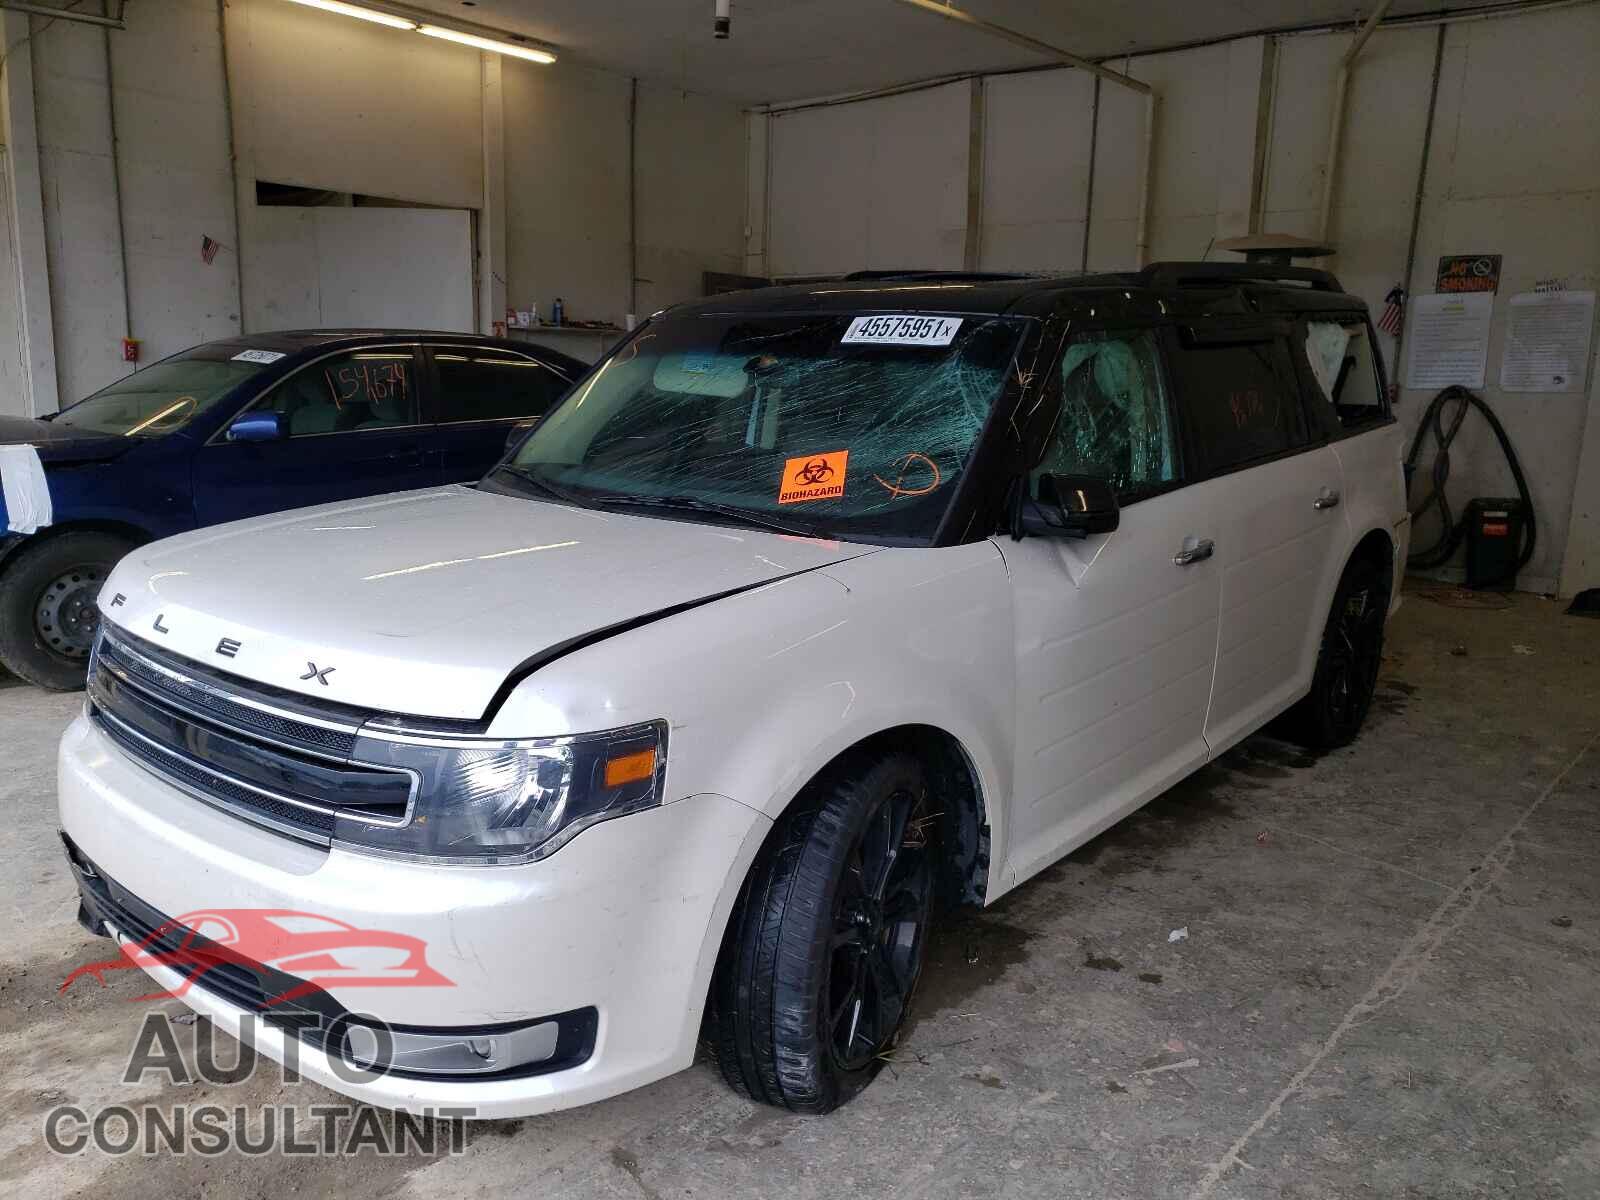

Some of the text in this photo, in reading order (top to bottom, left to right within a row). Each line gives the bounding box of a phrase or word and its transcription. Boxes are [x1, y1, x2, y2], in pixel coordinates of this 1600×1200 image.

[1440, 277, 1496, 291] SMOKING
[858, 317, 946, 338] 45575951
[781, 485, 842, 501] BIOHAZARD
[111, 592, 336, 686] FLEX
